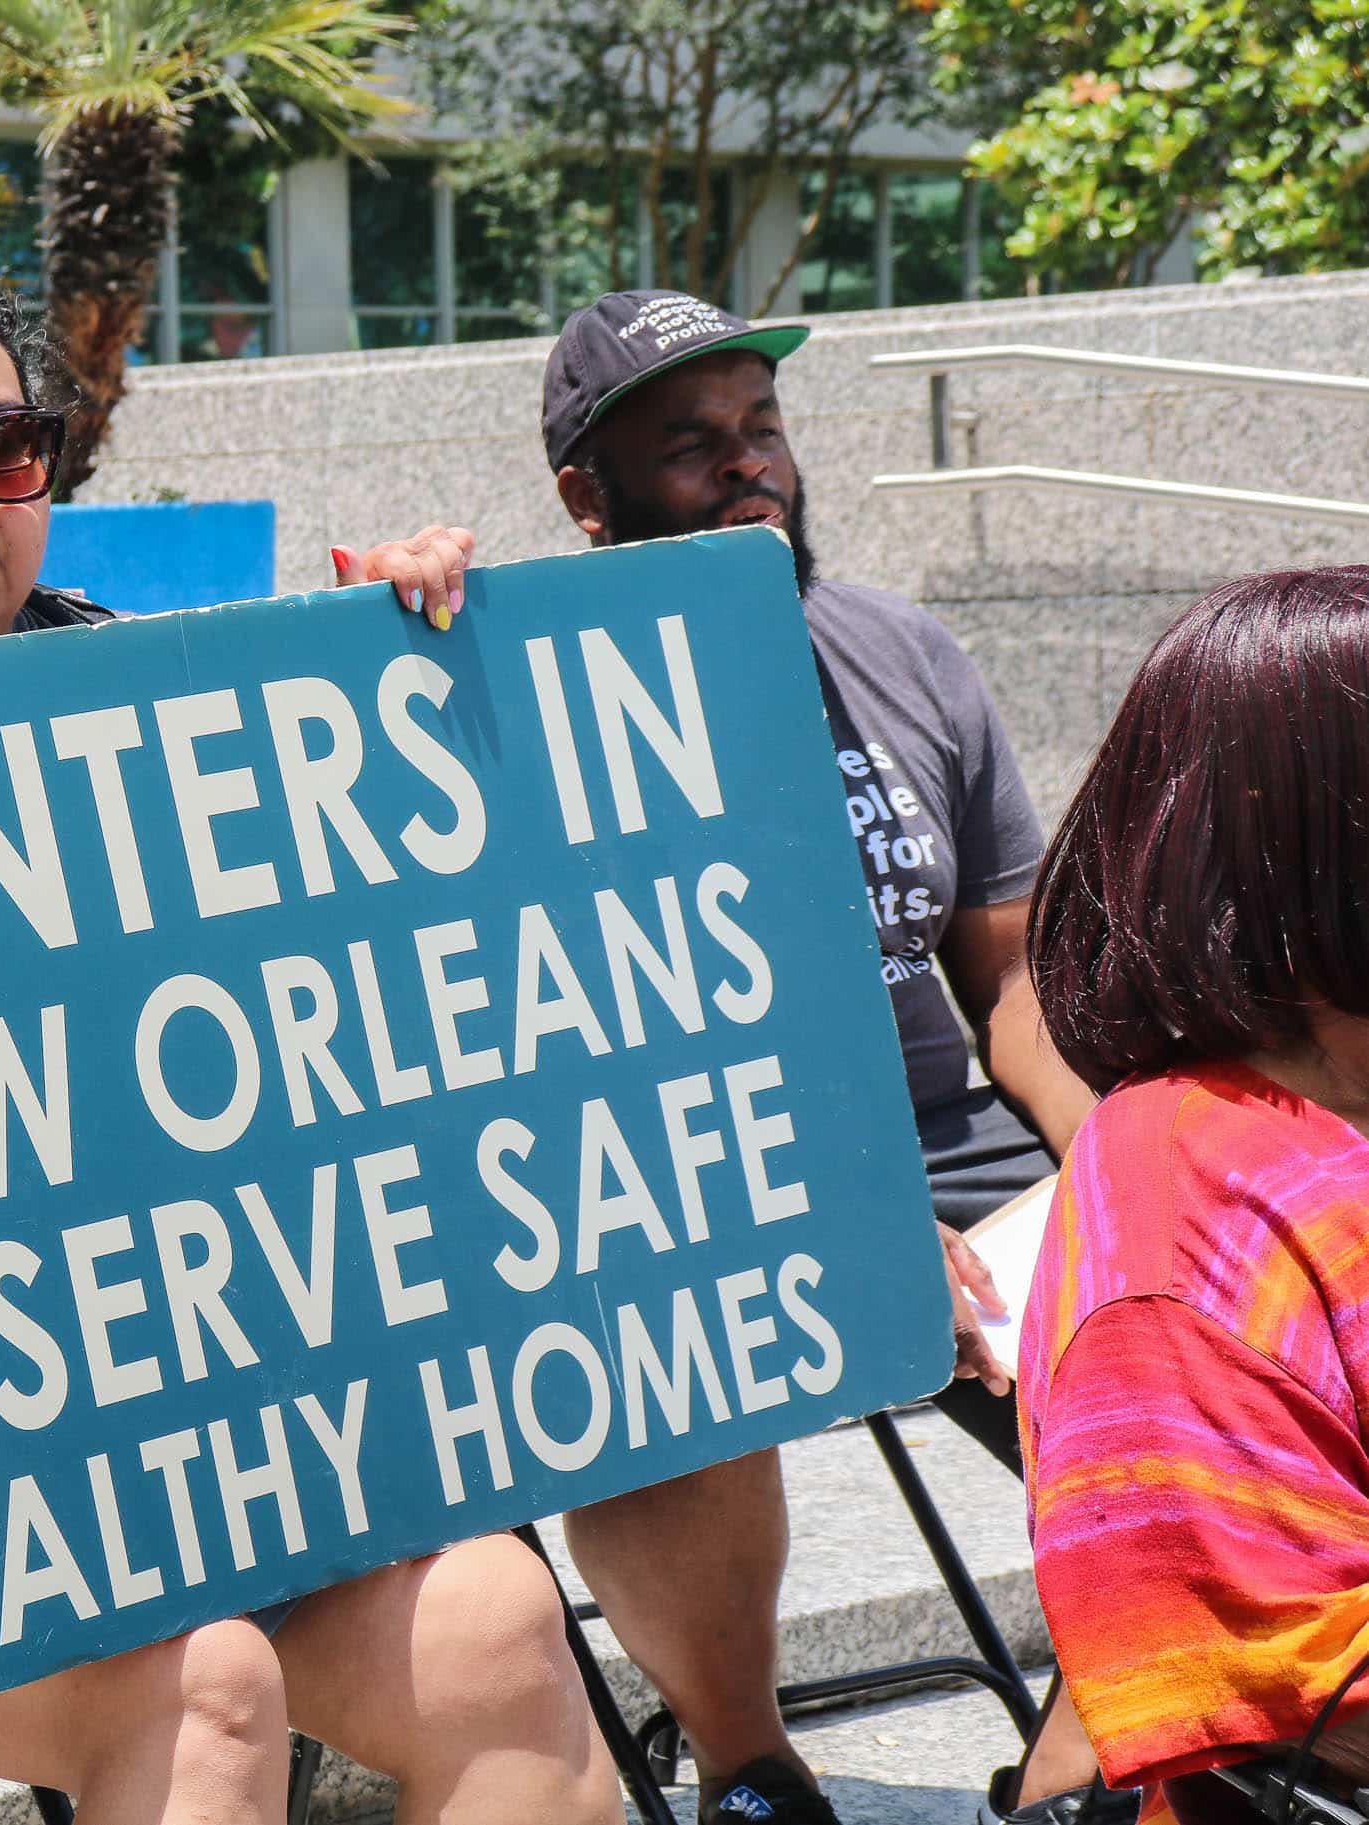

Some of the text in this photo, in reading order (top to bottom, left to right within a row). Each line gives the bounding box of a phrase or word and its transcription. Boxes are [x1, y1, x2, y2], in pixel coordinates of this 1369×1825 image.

[618, 302, 711, 339] for people
[655, 313, 693, 333] not
[655, 320, 734, 350] profits.
[526, 615, 724, 844] IN
[866, 830, 935, 874] for
[135, 863, 773, 1152] ORLEANS
[477, 1056, 810, 1292] SAFE
[419, 1253, 843, 1505] HOMES
